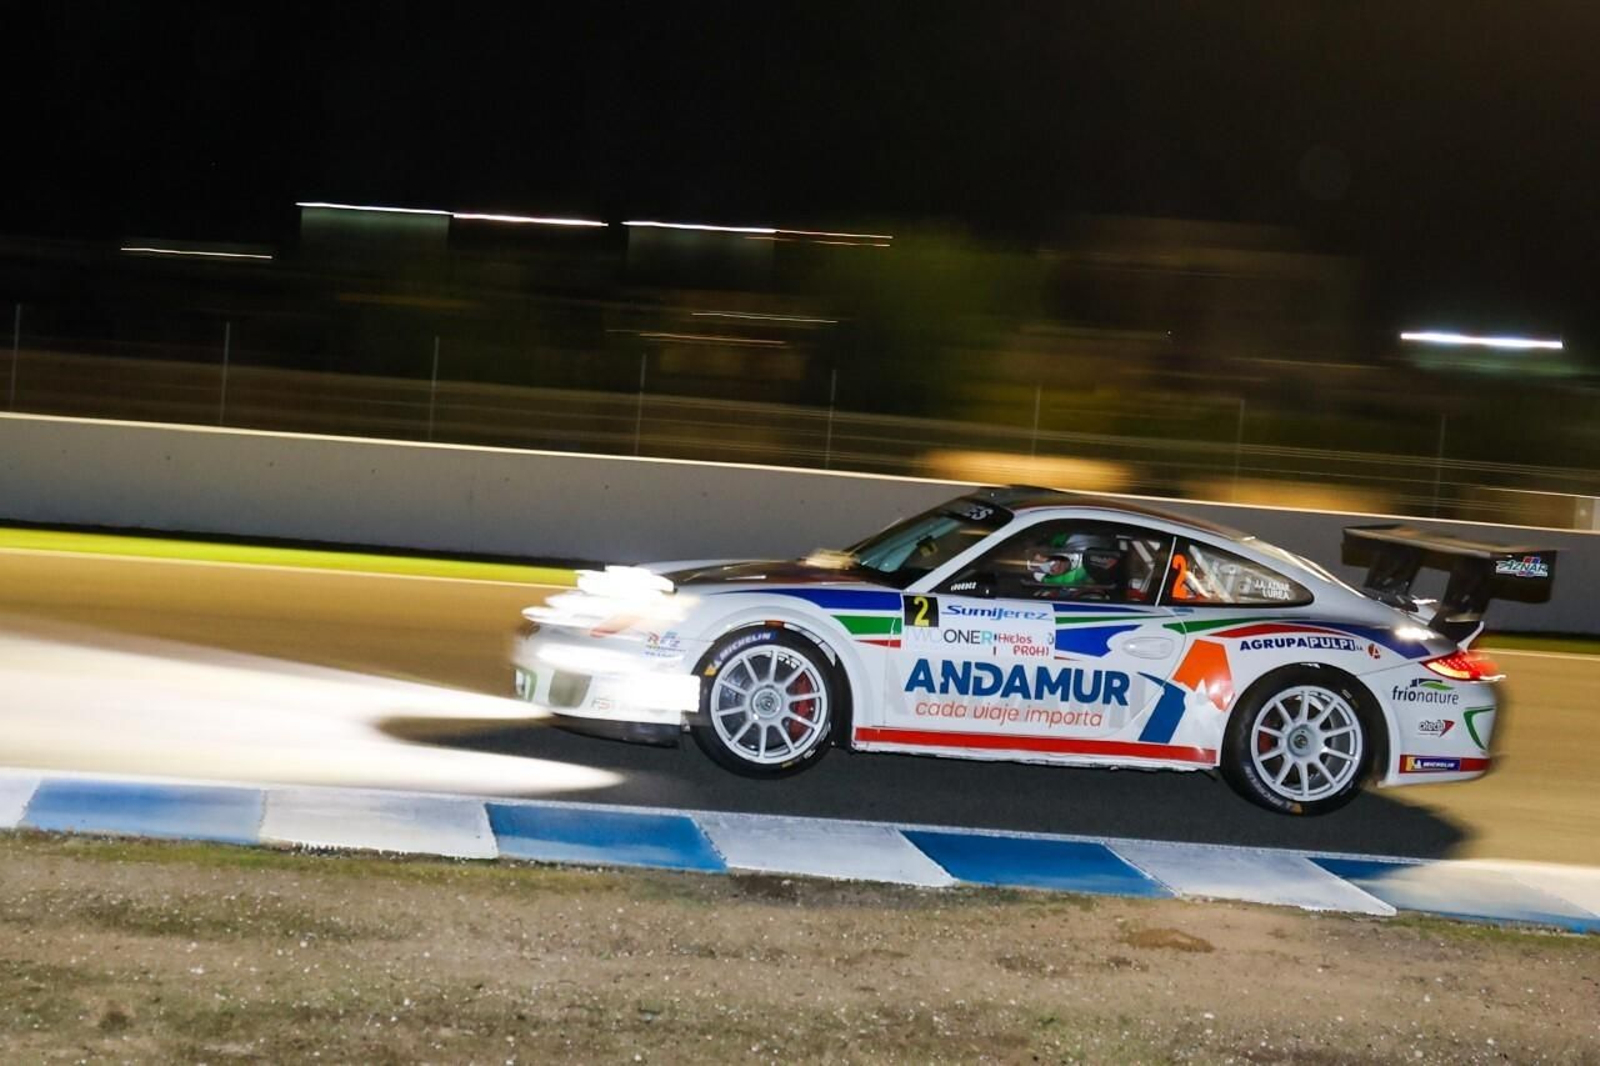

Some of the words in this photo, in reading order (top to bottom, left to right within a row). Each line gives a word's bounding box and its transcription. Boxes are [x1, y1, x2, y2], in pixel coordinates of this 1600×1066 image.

[1172, 554, 1190, 600] 2
[913, 596, 930, 627] 2
[719, 632, 771, 663] MICHELIN
[904, 658, 1130, 706] ANDAMUR
[1392, 686, 1460, 705] frionature
[915, 701, 966, 719] cada
[973, 705, 1020, 726] viaje
[1025, 709, 1102, 728] importa
